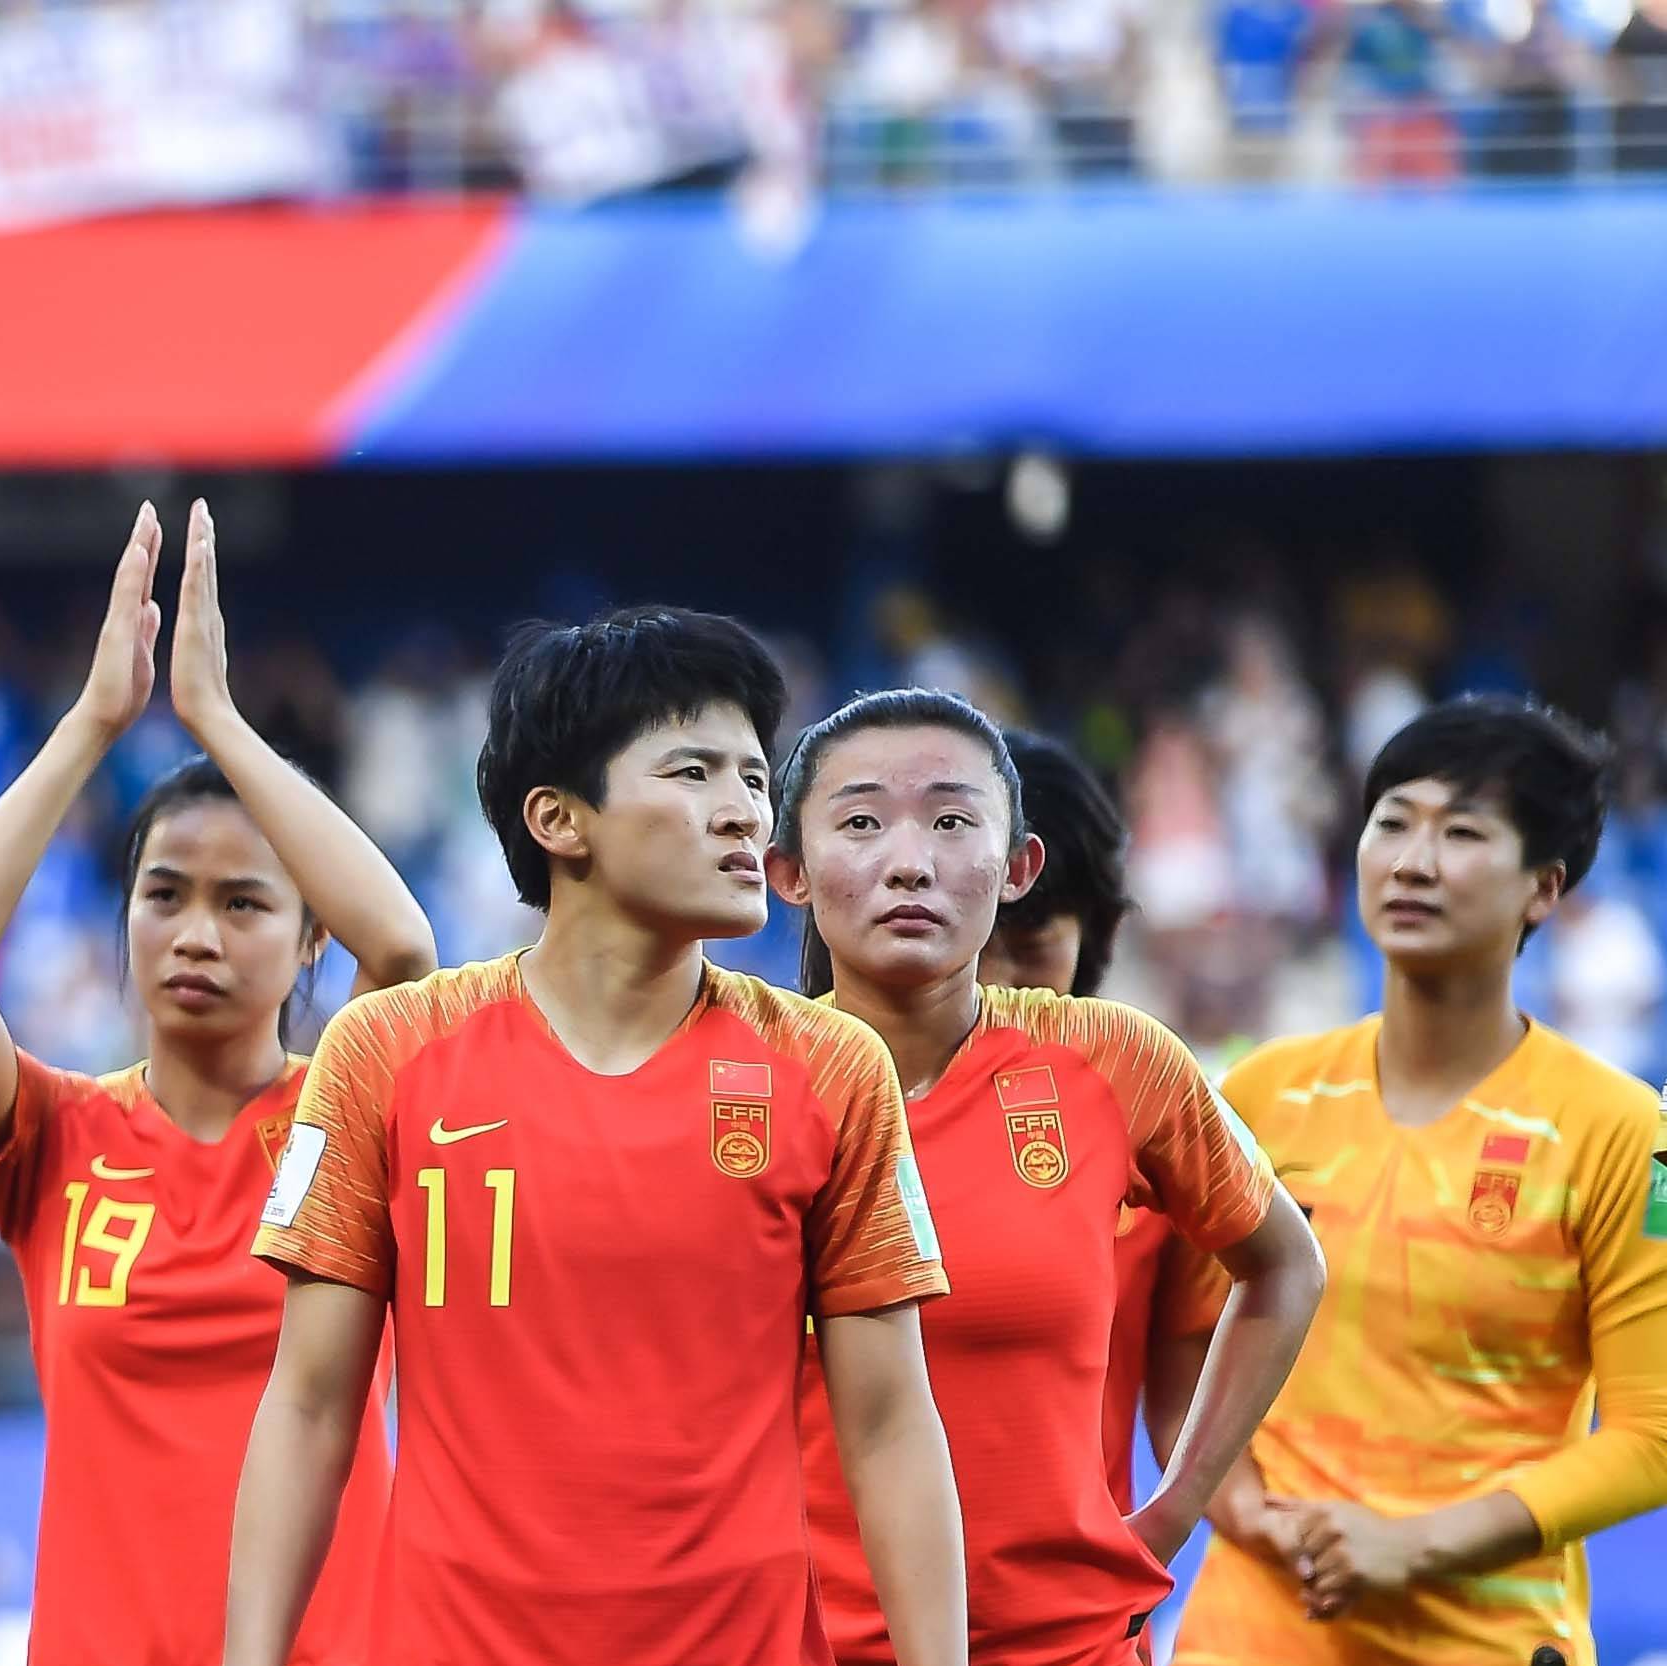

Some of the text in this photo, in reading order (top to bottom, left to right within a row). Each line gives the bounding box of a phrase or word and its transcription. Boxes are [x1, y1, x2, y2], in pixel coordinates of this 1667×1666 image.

[716, 1104, 765, 1122] CFA
[1010, 1115, 1057, 1133] CFA
[57, 1181, 156, 1307] 19
[416, 1167, 516, 1307] 11
